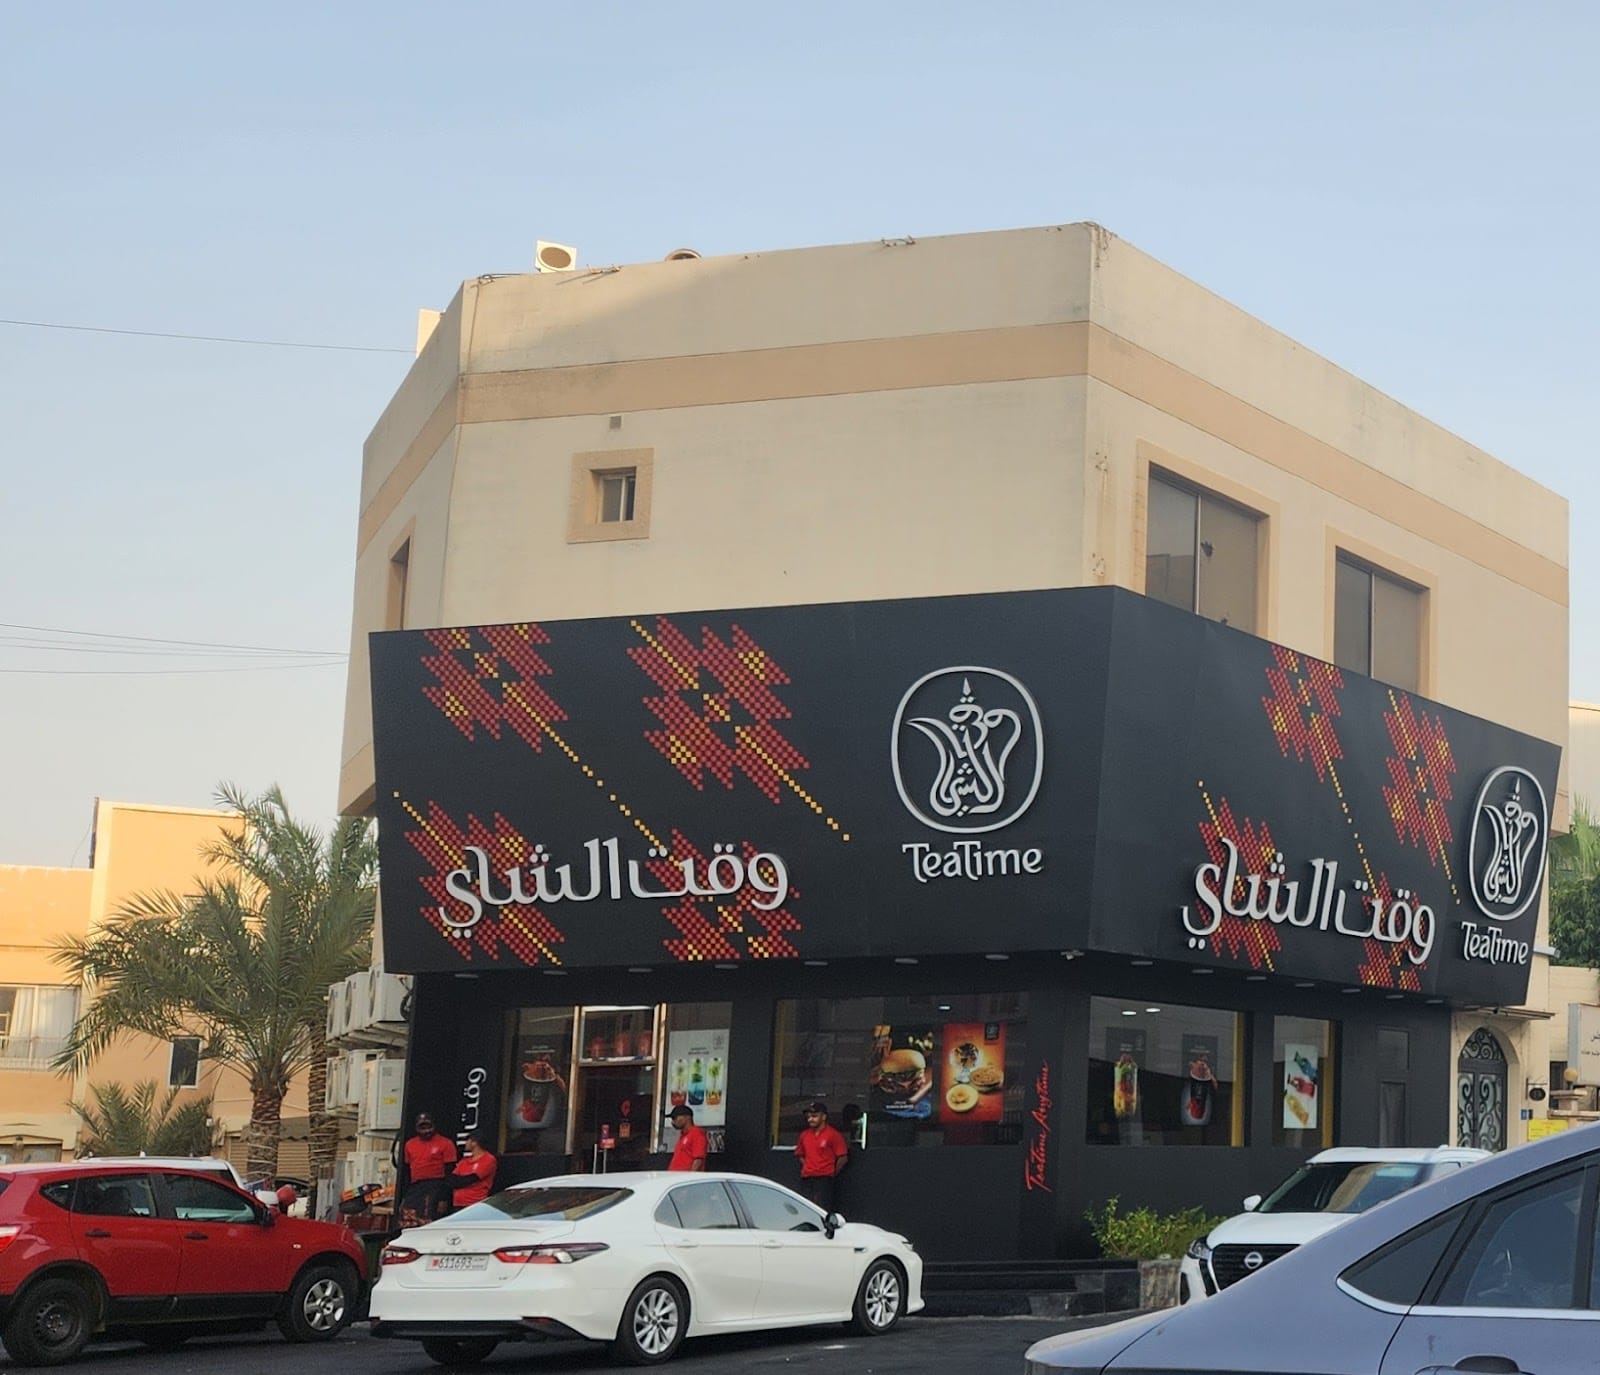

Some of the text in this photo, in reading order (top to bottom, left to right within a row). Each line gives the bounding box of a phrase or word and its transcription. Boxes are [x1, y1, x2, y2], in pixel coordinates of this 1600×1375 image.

[439, 836, 789, 939] وقت الشاي
[902, 840, 1044, 883] TeaTime
[1181, 837, 1436, 965] وقت الشاي
[1461, 921, 1529, 965] TeaTime
[461, 1067, 487, 1130] وقت
